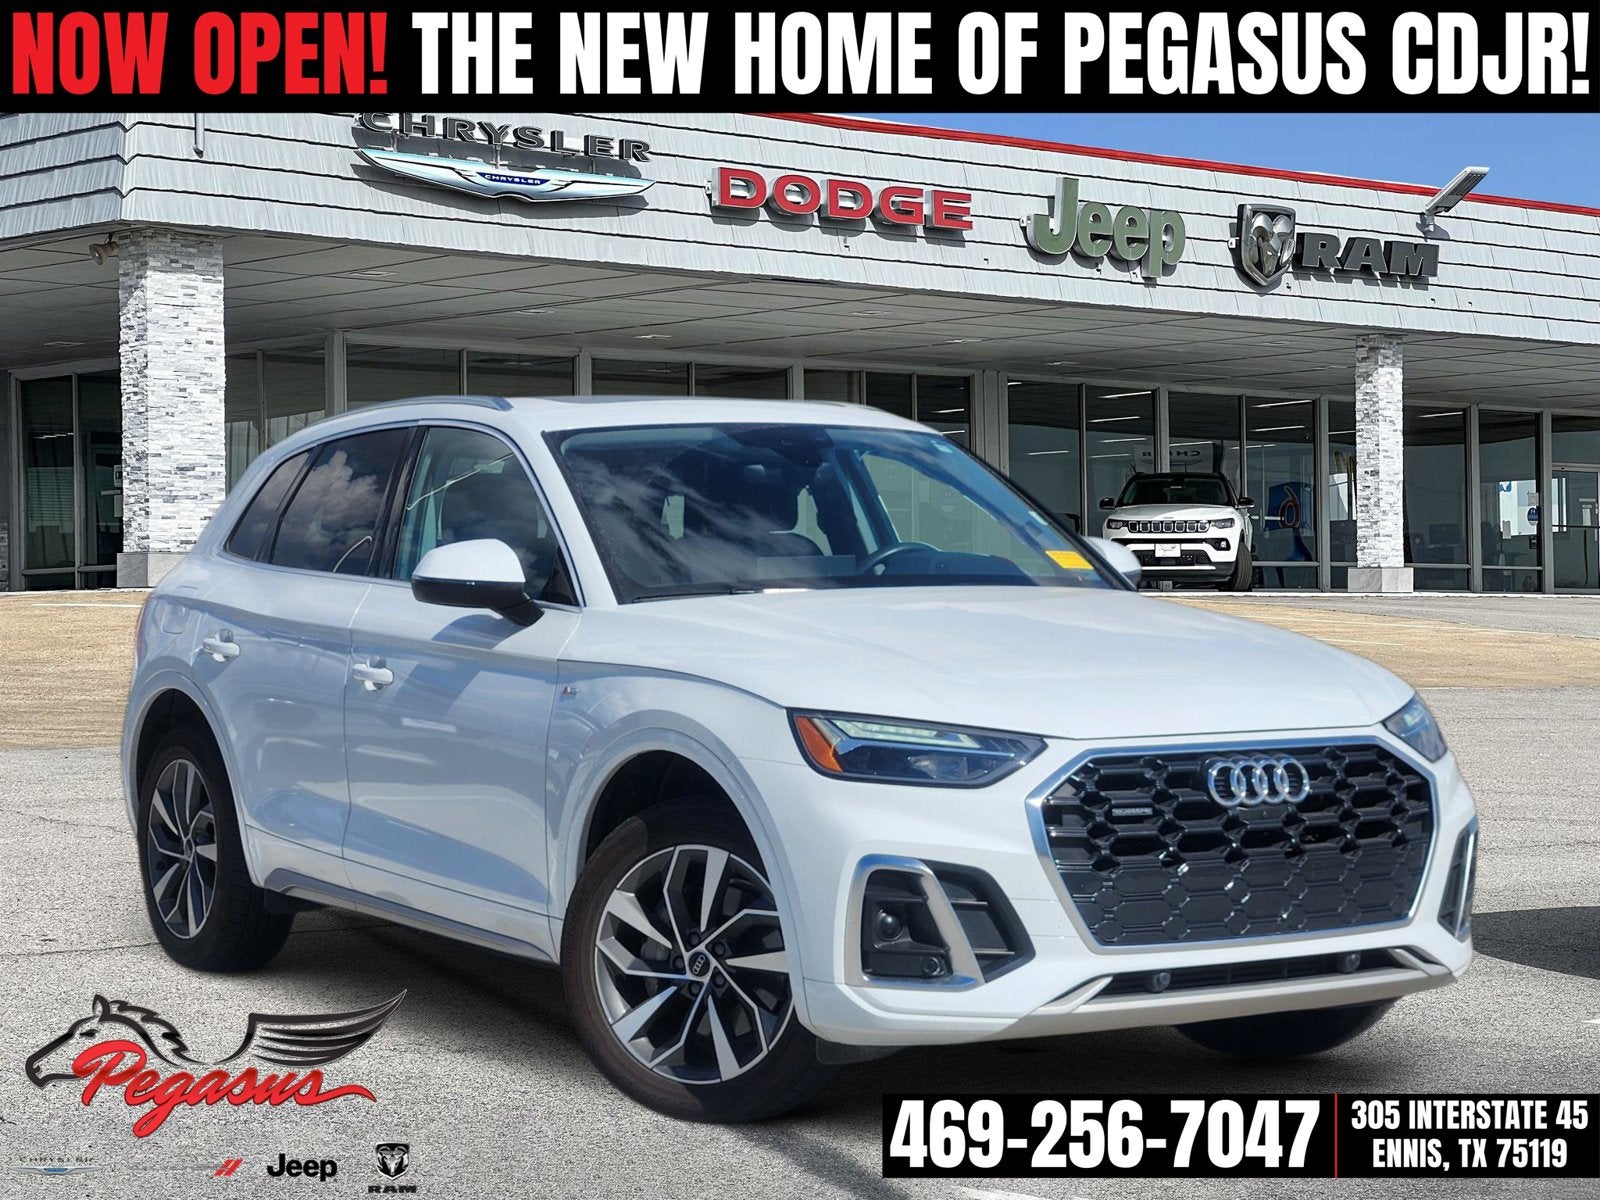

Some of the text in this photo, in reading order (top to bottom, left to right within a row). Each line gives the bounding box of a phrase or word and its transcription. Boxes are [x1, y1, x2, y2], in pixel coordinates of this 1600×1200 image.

[359, 112, 651, 162] CHRYSLER
[484, 174, 541, 185] CHRYSLER
[713, 167, 973, 231] DODGE
[1027, 177, 1186, 278] Jeep
[1297, 232, 1440, 277] RAM
